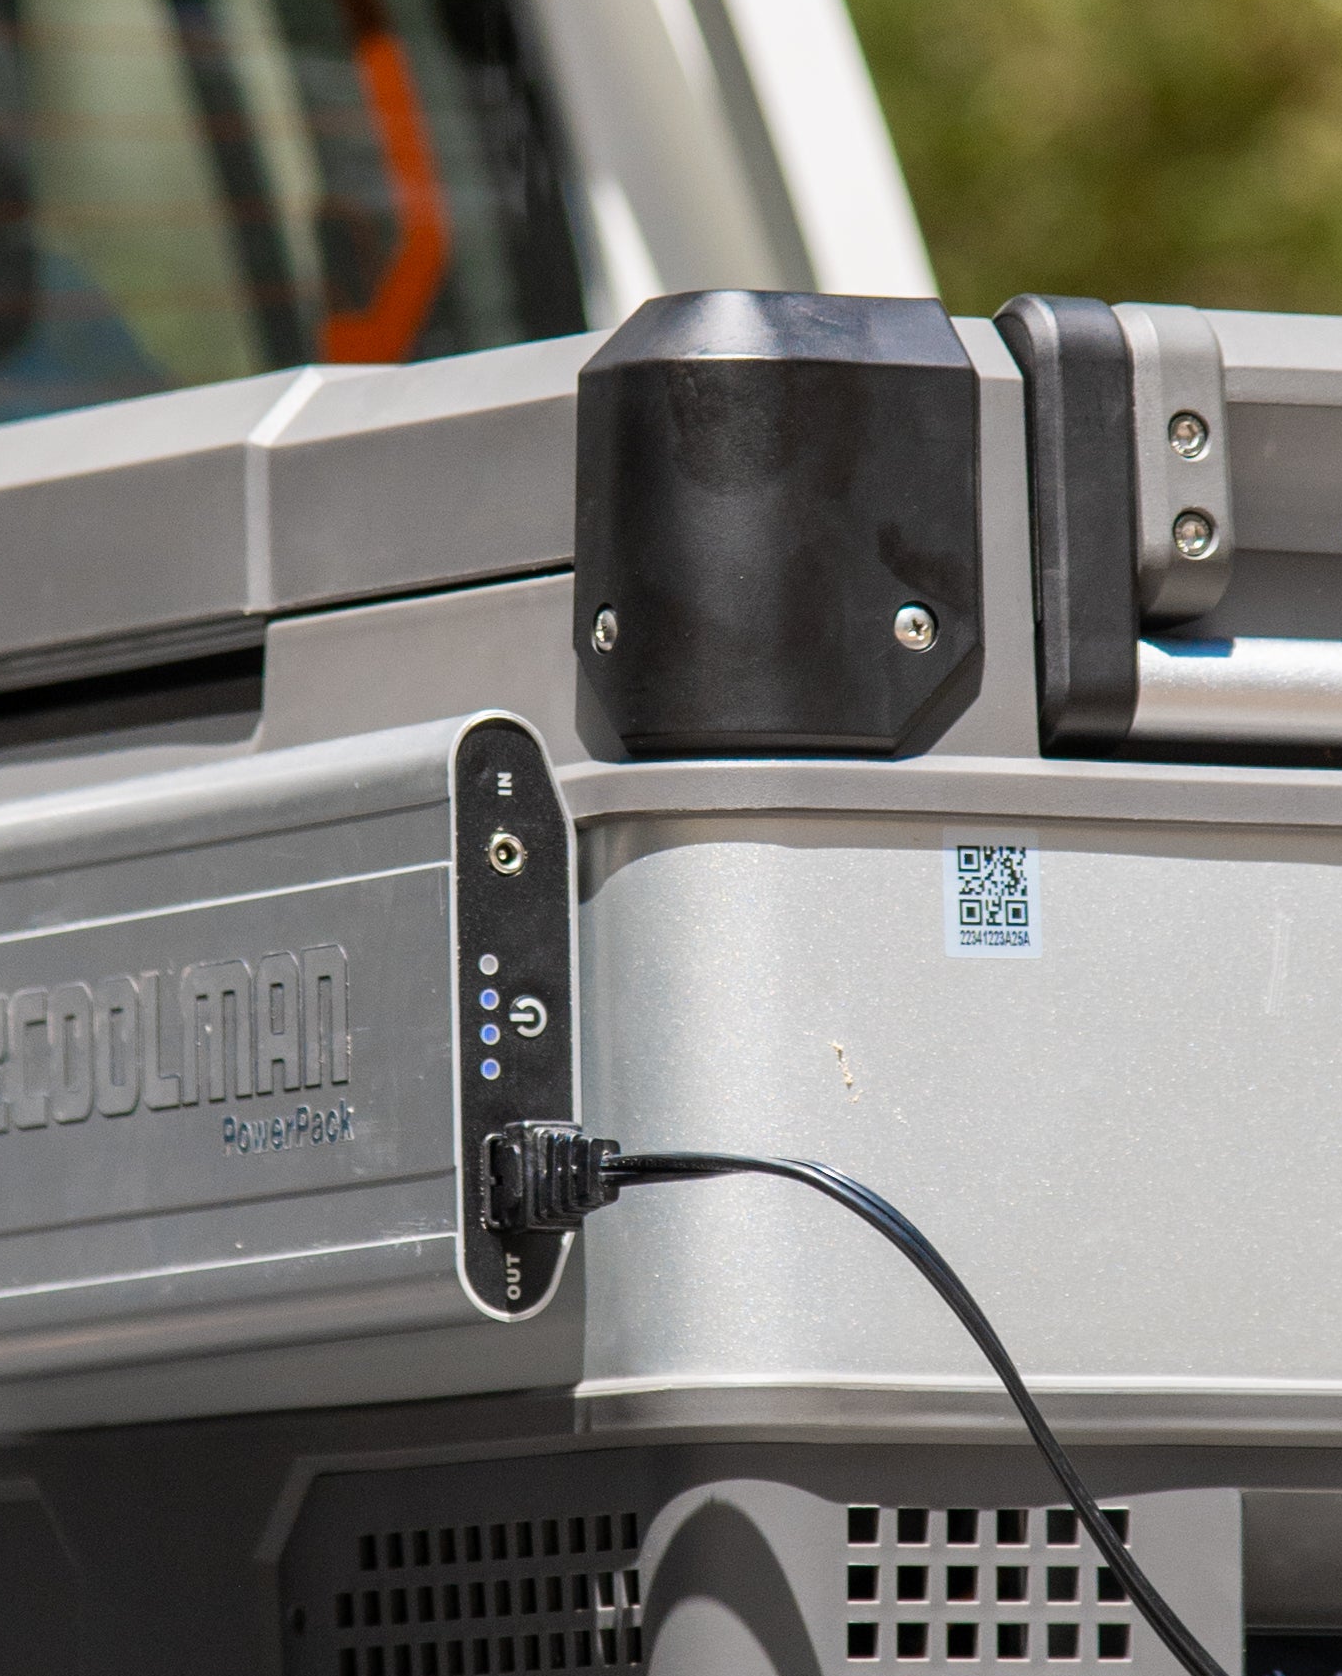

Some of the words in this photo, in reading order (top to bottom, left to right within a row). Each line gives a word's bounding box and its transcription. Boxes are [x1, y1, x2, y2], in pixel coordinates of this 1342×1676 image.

[497, 772, 513, 796] IN
[222, 1097, 355, 1157] PowerPack
[505, 1252, 522, 1301] OUT
